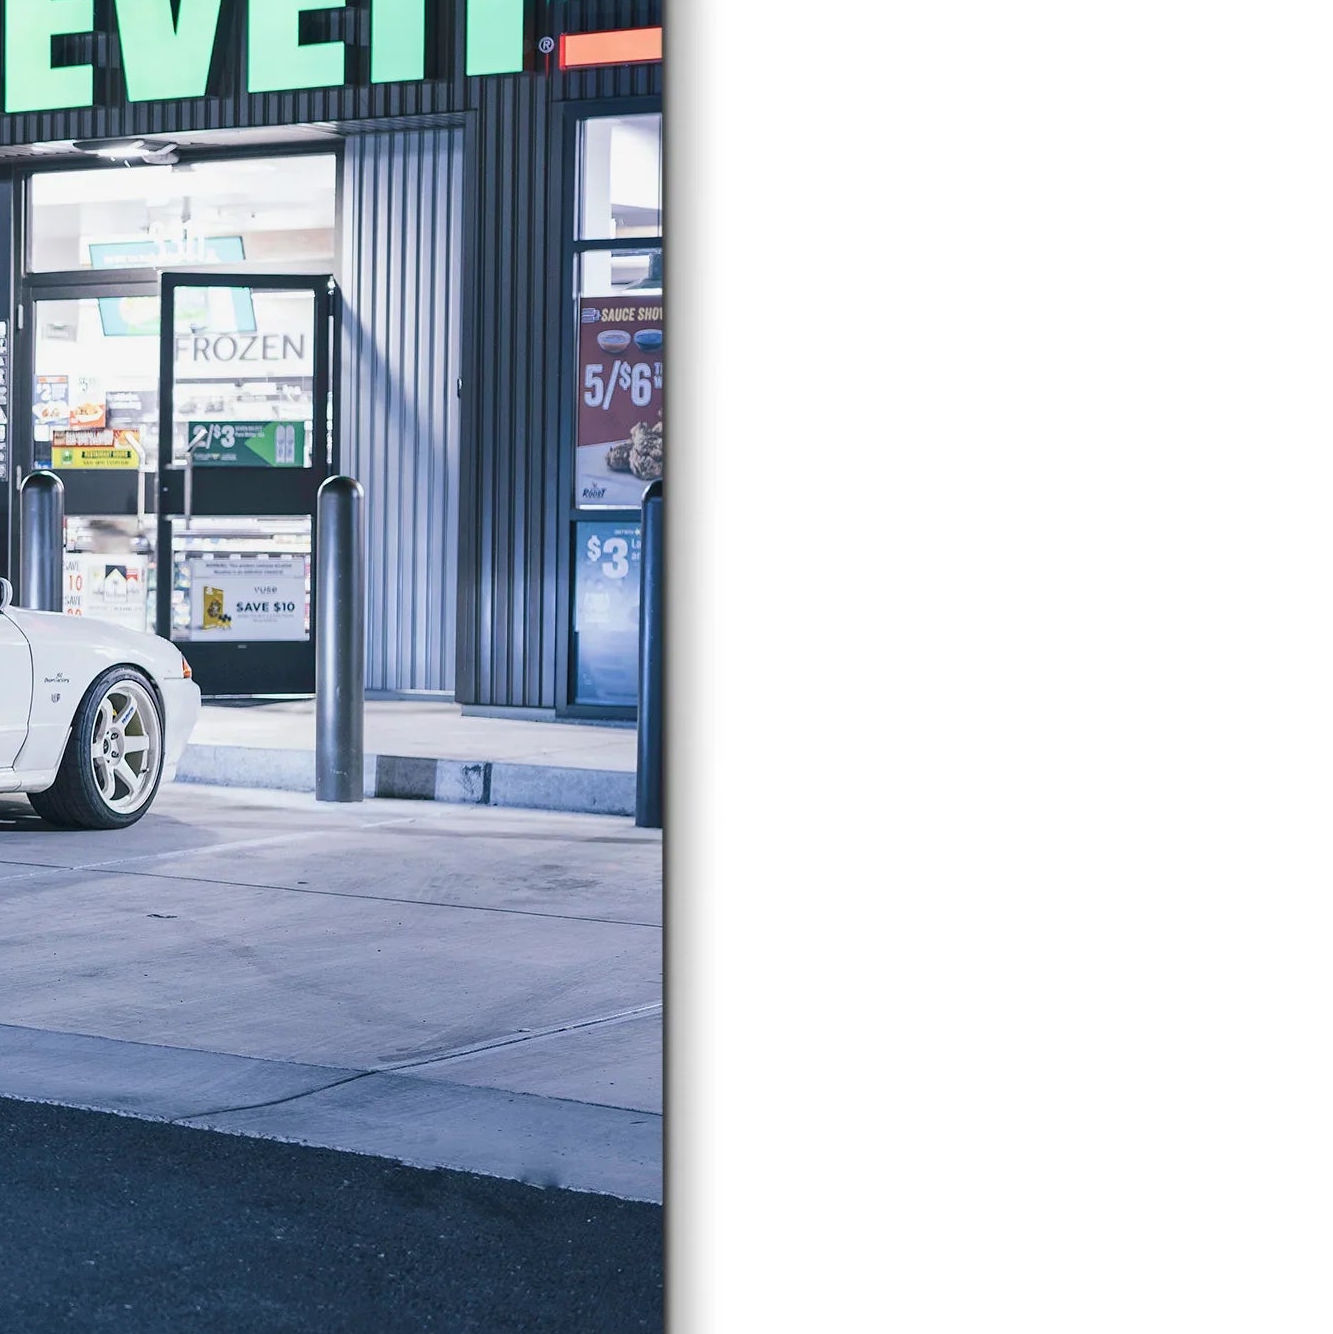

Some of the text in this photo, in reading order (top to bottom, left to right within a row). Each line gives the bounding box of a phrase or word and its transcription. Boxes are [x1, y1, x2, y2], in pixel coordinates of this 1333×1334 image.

[601, 308, 636, 322] SAUCE
[175, 334, 305, 361] FROZEN
[584, 360, 652, 411] 5/$6
[193, 424, 235, 449] 2/$3
[587, 535, 629, 579] $3
[236, 600, 296, 613] SAVE $10
